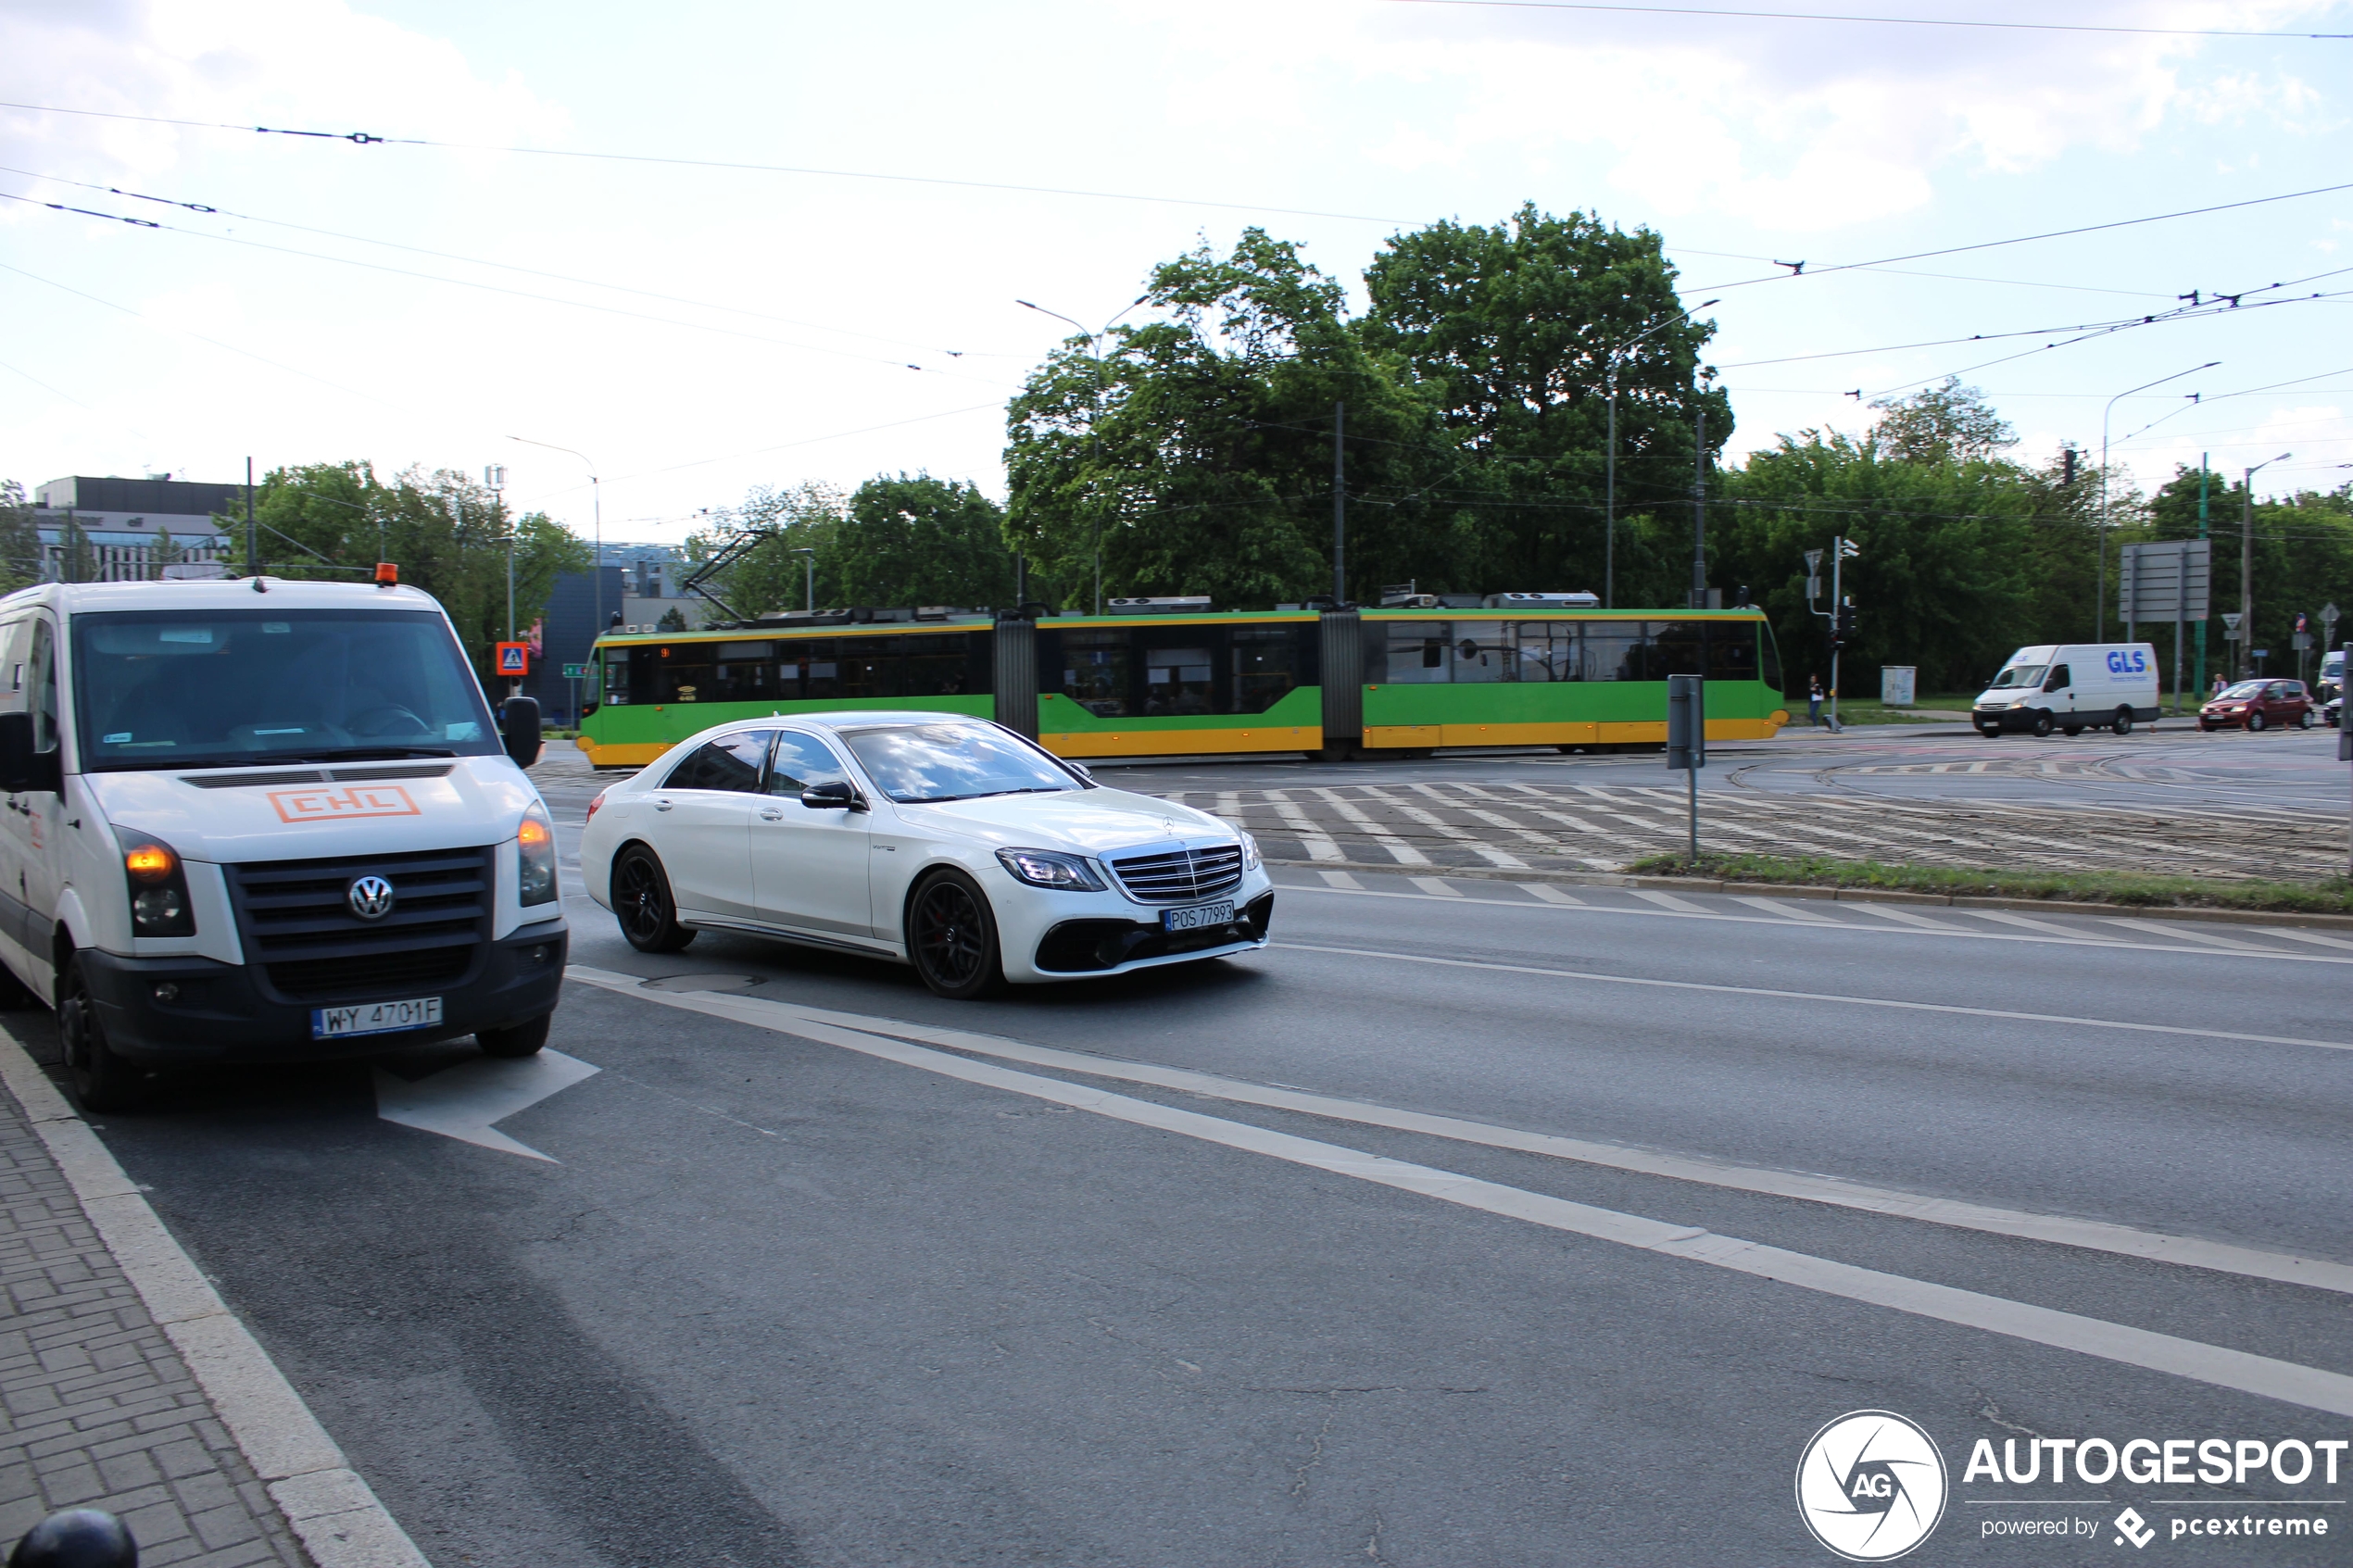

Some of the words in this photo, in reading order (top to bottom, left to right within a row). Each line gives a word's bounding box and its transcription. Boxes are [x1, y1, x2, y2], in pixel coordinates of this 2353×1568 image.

[1171, 909, 1197, 930] POS
[1200, 904, 1233, 925] 77993
[327, 1007, 360, 1032] WY
[371, 998, 440, 1022] 4701F
